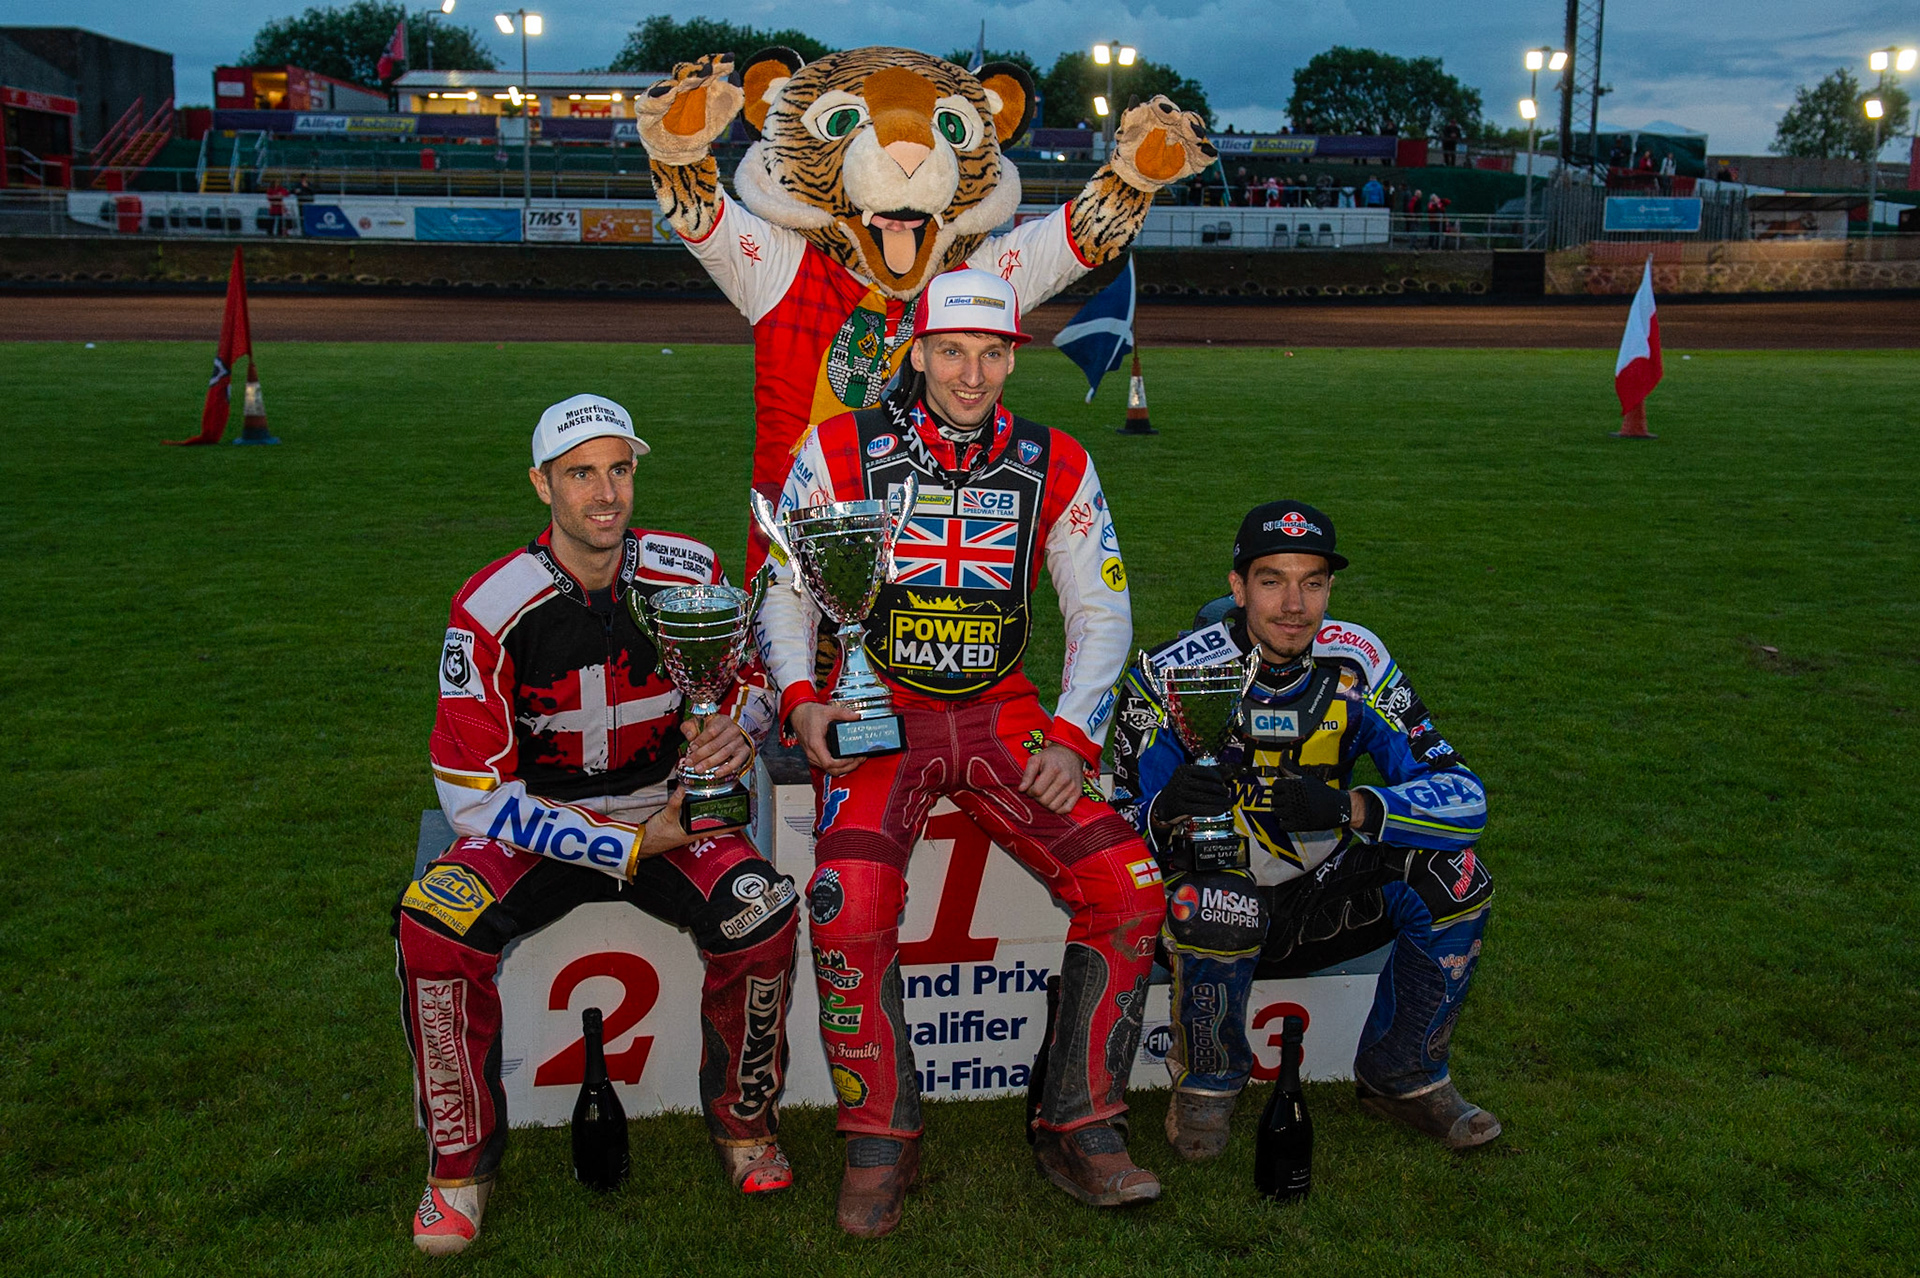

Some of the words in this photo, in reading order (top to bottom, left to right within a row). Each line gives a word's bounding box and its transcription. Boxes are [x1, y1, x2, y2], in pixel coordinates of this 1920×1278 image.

[300, 114, 346, 129] Allied
[349, 116, 414, 133] Mobility
[1256, 139, 1315, 152] Mobility
[528, 211, 564, 226] TMS
[557, 415, 593, 434] HANSEN
[595, 414, 603, 422] &
[565, 404, 616, 421] Murerfirma
[868, 436, 890, 451] ACU
[1020, 442, 1040, 454] SGB
[963, 507, 995, 516] SPEEDWAY
[997, 508, 1014, 517] TEAM
[981, 492, 1014, 510] GB
[895, 616, 996, 644] POWER
[894, 639, 995, 672] MAXED
[1255, 715, 1295, 731] GPA
[1405, 779, 1482, 809] GPA
[487, 796, 624, 868] Nice
[427, 874, 483, 909] HELLA
[403, 896, 431, 911] SERVICE
[432, 904, 467, 933] PARTNER
[724, 904, 764, 936] bjarne
[1200, 908, 1259, 929] GRUPPEN
[973, 960, 1050, 995] Prix
[533, 951, 660, 1087] 2
[838, 1014, 860, 1025] OIL
[421, 999, 444, 1071] SERVICE
[437, 1001, 459, 1073] PADBORG
[1250, 1001, 1311, 1081] 3
[838, 1041, 880, 1060] Family
[430, 1077, 466, 1148] B&K
